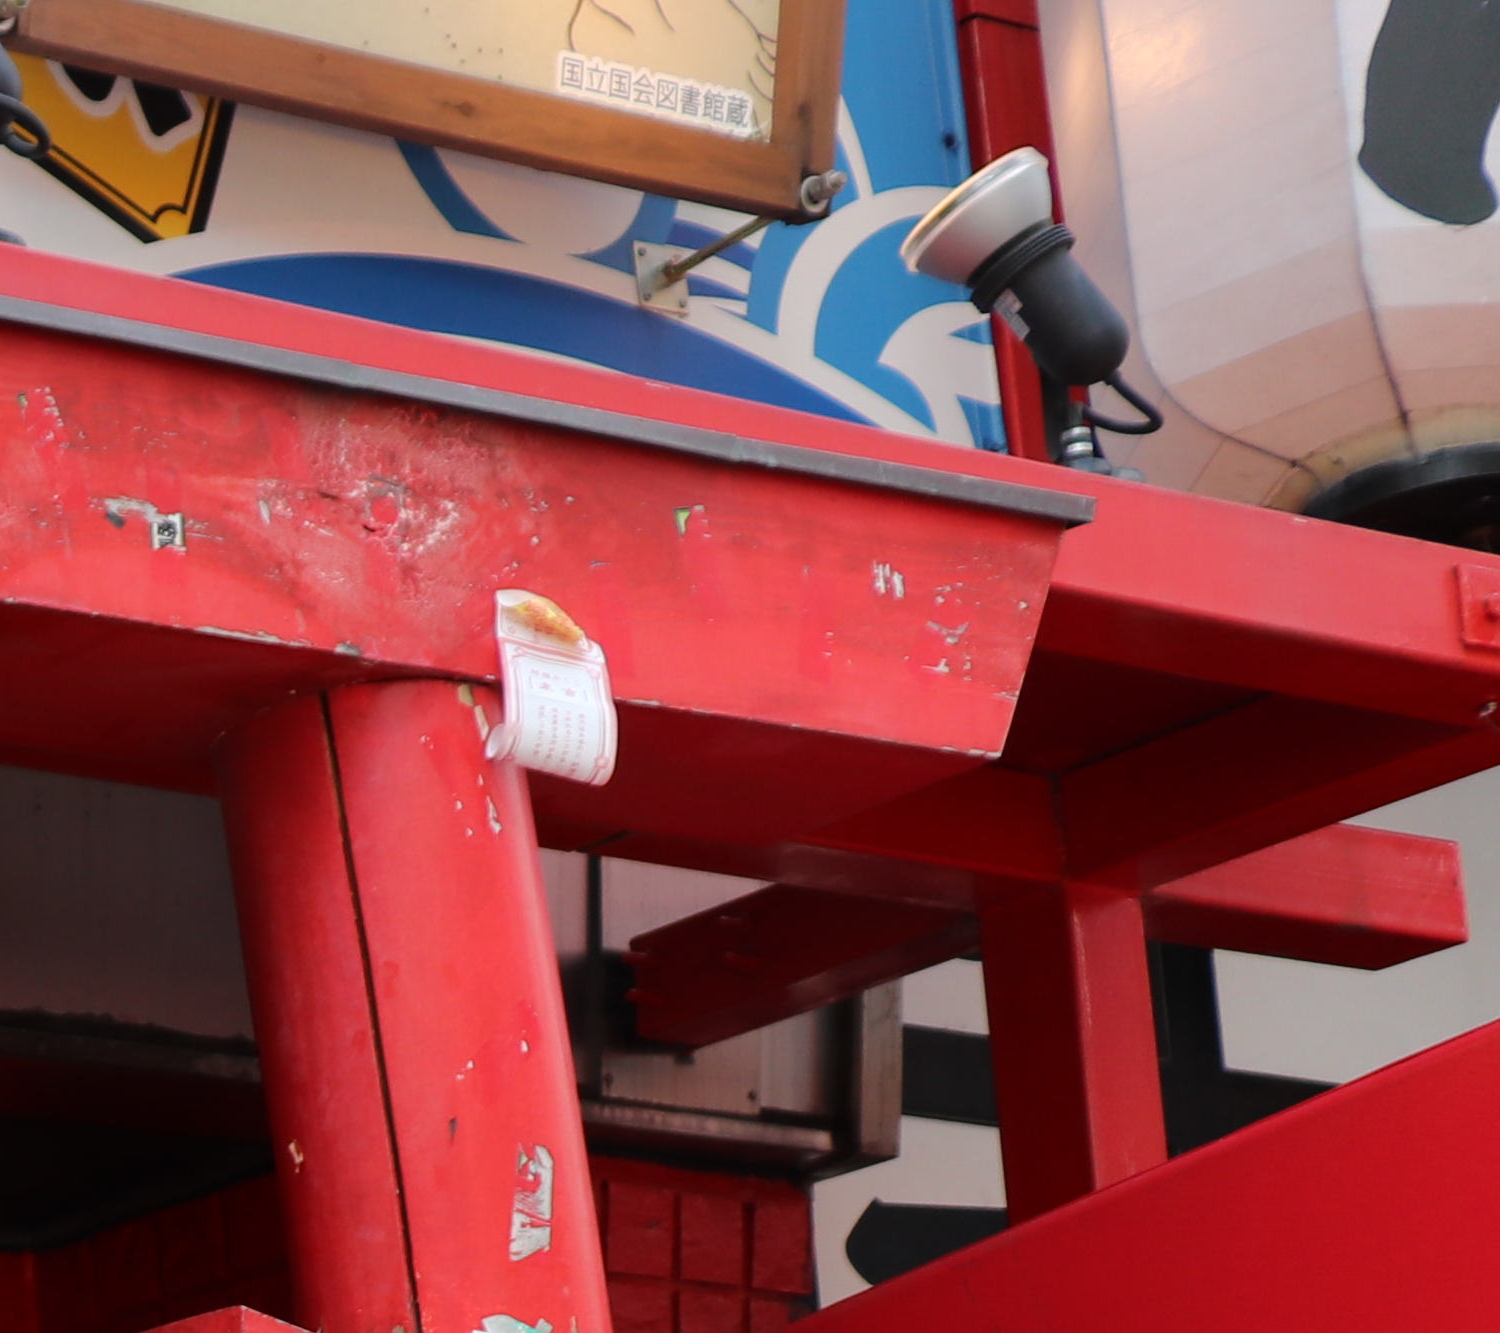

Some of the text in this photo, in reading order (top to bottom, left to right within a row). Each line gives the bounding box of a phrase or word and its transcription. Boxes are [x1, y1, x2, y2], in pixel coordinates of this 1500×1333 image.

[560, 56, 750, 128] 国立国会図書館蔵
